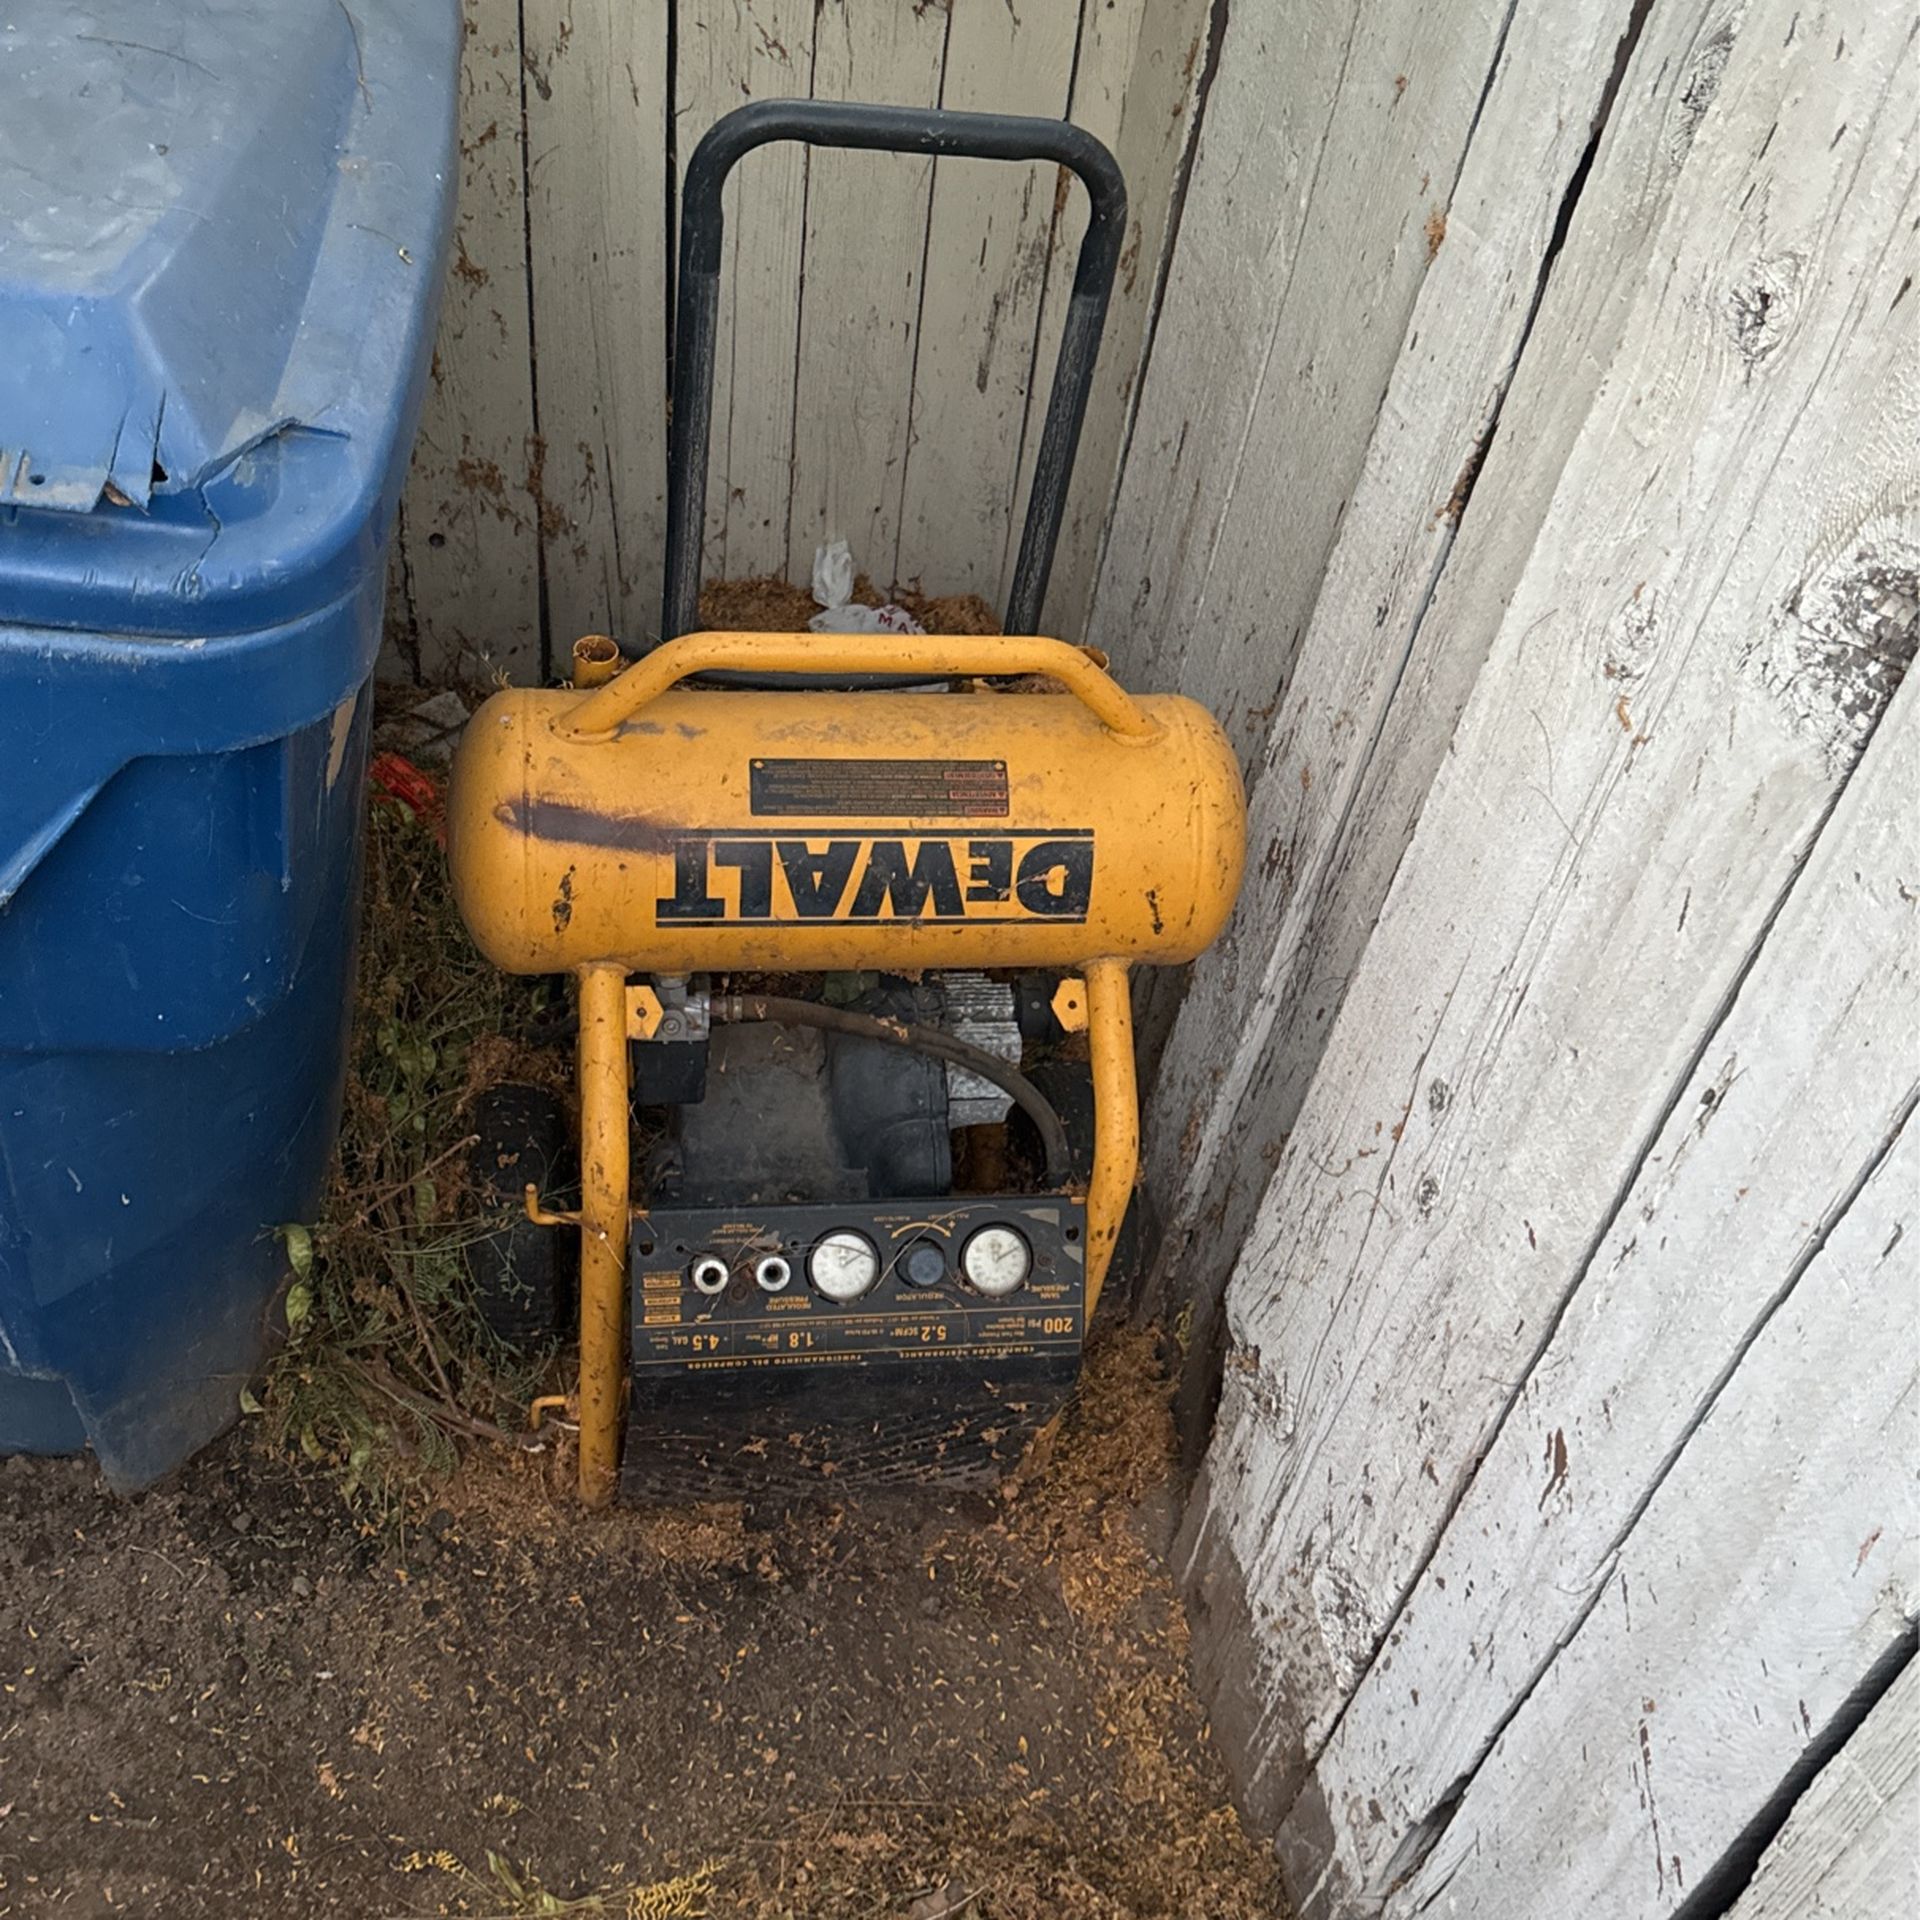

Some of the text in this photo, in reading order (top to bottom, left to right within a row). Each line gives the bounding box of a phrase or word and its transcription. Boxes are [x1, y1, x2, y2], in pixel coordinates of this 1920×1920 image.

[766, 1302, 812, 1311] REGULATED
[1027, 1319, 1041, 1328] PSI
[1044, 1317, 1073, 1333] 200
[921, 1325, 947, 1342] 5.2
[672, 1333, 719, 1352] 4.5 GAL
[789, 1331, 814, 1348] 1.8
[972, 1345, 1034, 1355] COMPRESSOR
[688, 1360, 747, 1370] COMPRESOR
[774, 1354, 862, 1365] FUNCIONAMIENTO
